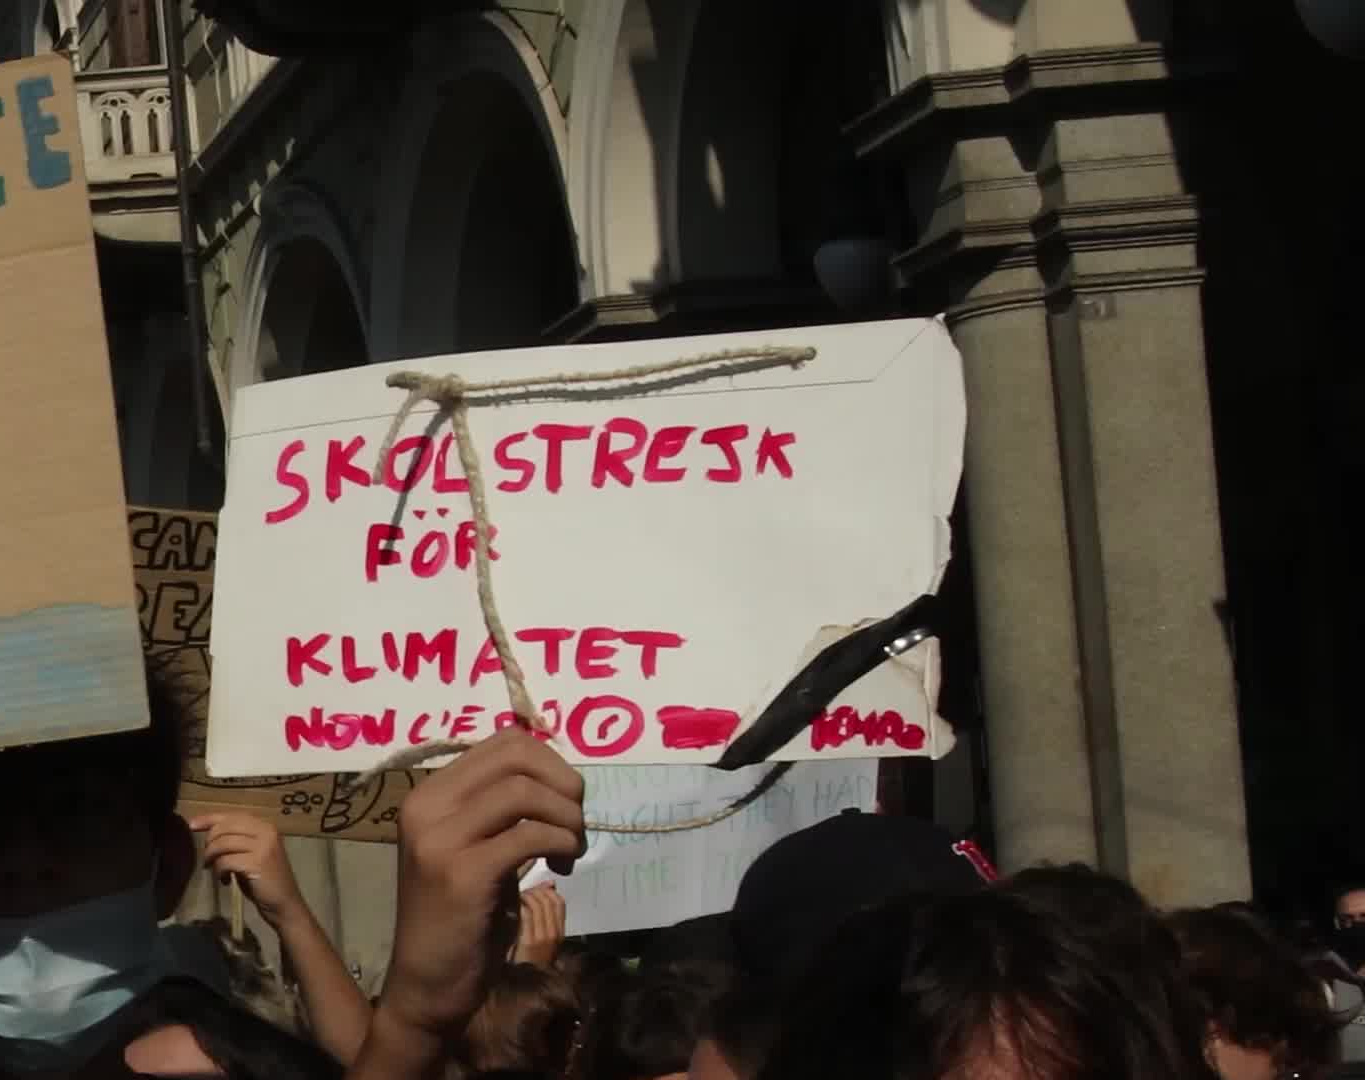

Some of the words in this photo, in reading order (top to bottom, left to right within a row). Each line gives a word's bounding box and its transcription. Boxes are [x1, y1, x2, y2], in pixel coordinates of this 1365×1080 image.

[363, 504, 502, 583] FÖR
[284, 627, 688, 689] KLIMATET
[284, 705, 398, 752] NON
